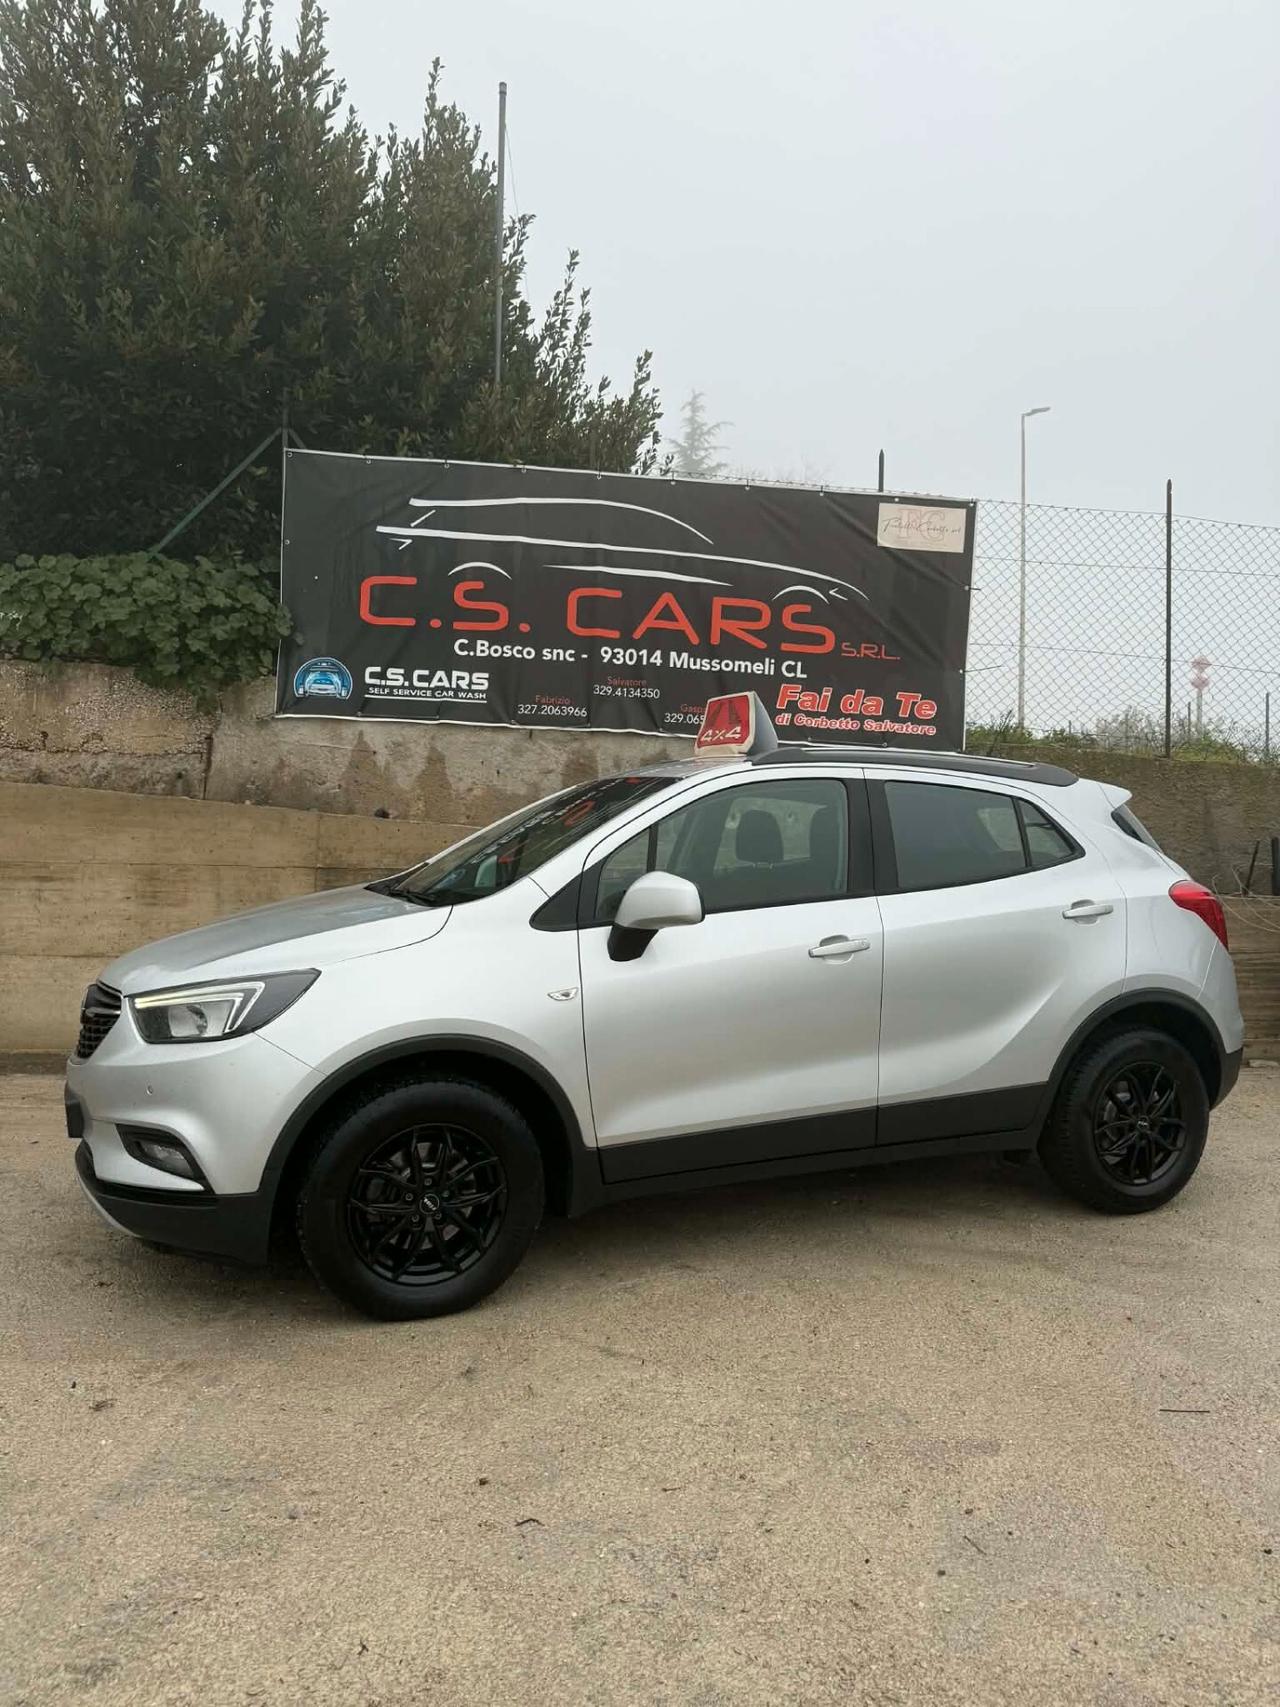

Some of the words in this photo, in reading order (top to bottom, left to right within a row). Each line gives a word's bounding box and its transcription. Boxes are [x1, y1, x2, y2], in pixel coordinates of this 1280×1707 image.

[566, 587, 837, 654] CARS
[840, 642, 900, 660] S.R.L.
[453, 638, 536, 661] C.Bosco
[542, 648, 576, 662] snc
[600, 646, 663, 667] 93014
[669, 652, 775, 676] Mussomeli
[781, 660, 808, 679] CL
[606, 676, 647, 687] Salvatore
[368, 687, 390, 695] SELF
[393, 688, 433, 697] SERVICE
[435, 690, 455, 698] CAR
[458, 691, 487, 699] WASH
[593, 684, 661, 699] 329.4134350
[535, 694, 571, 705] Fabrizio
[775, 683, 833, 713] Fai
[840, 689, 884, 716] da
[896, 692, 938, 719] Te
[517, 704, 588, 718] 327.2063966
[775, 712, 792, 726] di
[794, 713, 861, 730] Corbetto
[863, 719, 937, 735] Salvatore
